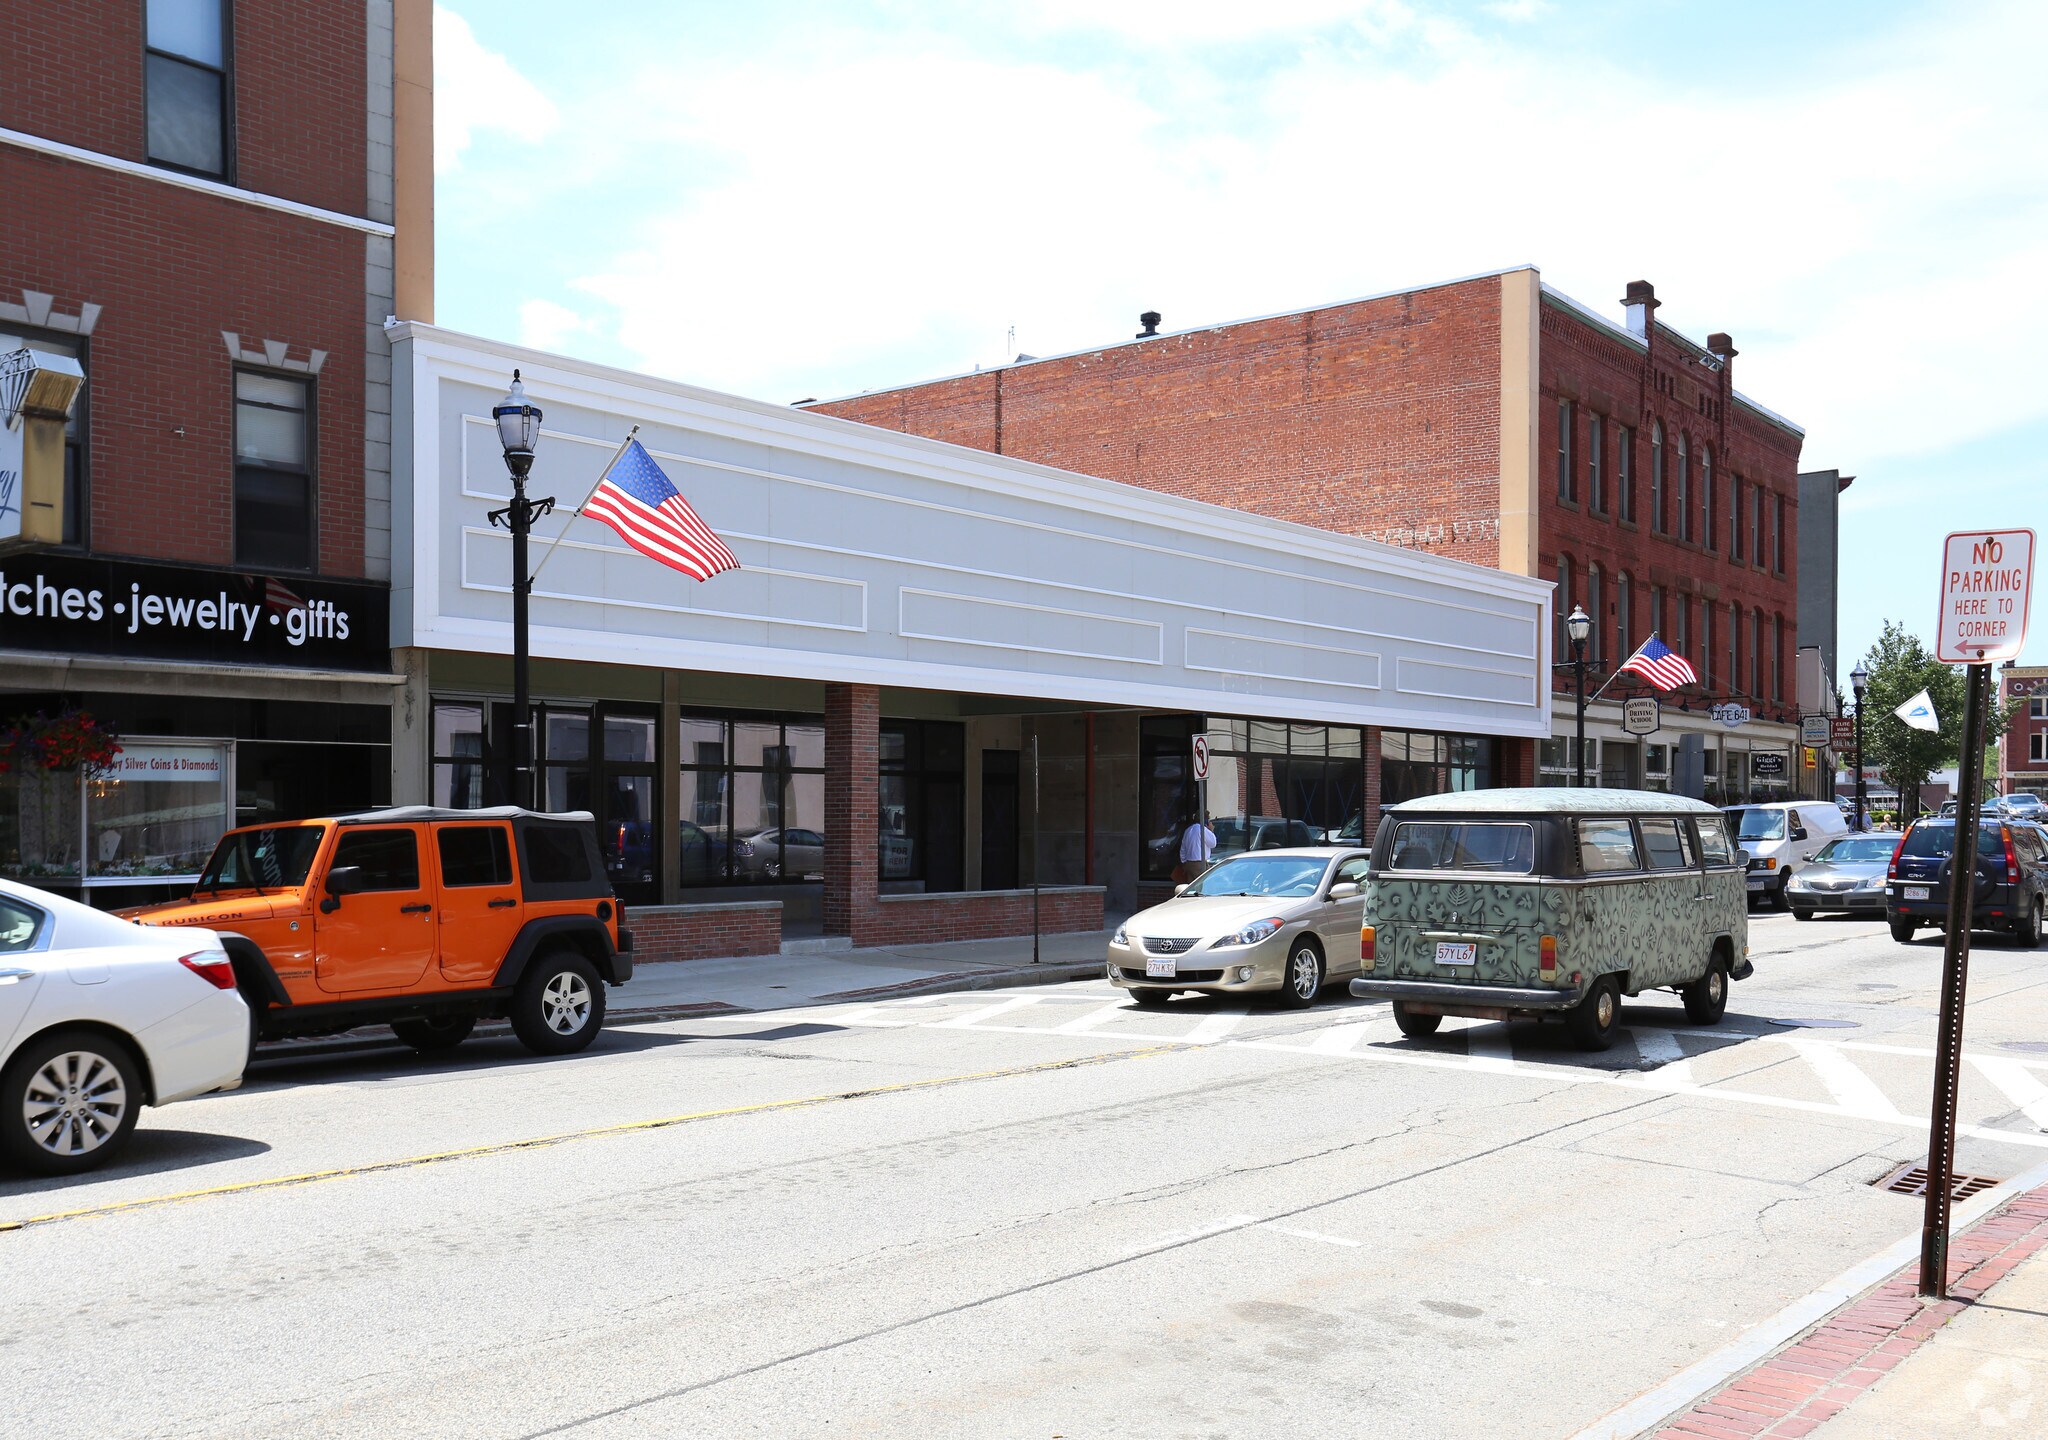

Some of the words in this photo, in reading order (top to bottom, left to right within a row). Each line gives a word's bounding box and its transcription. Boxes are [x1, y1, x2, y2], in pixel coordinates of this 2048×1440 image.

[1972, 541, 2003, 564] NO
[1950, 568, 2022, 593] PARKING
[127, 582, 261, 641] jewelry
[285, 599, 350, 646] gifts
[1954, 599, 1987, 615] HERE
[1998, 598, 2013, 614] TO
[1958, 621, 2007, 637] CORNER
[1734, 709, 1748, 720] 641
[125, 757, 147, 770] Silver
[150, 758, 171, 770] Coins
[173, 758, 179, 770] &
[181, 758, 219, 771] Diamonds
[891, 847, 908, 856] FOR
[161, 912, 243, 926] RUBICON
[1438, 947, 1456, 959] 57Y
[1456, 948, 1474, 960] L67
